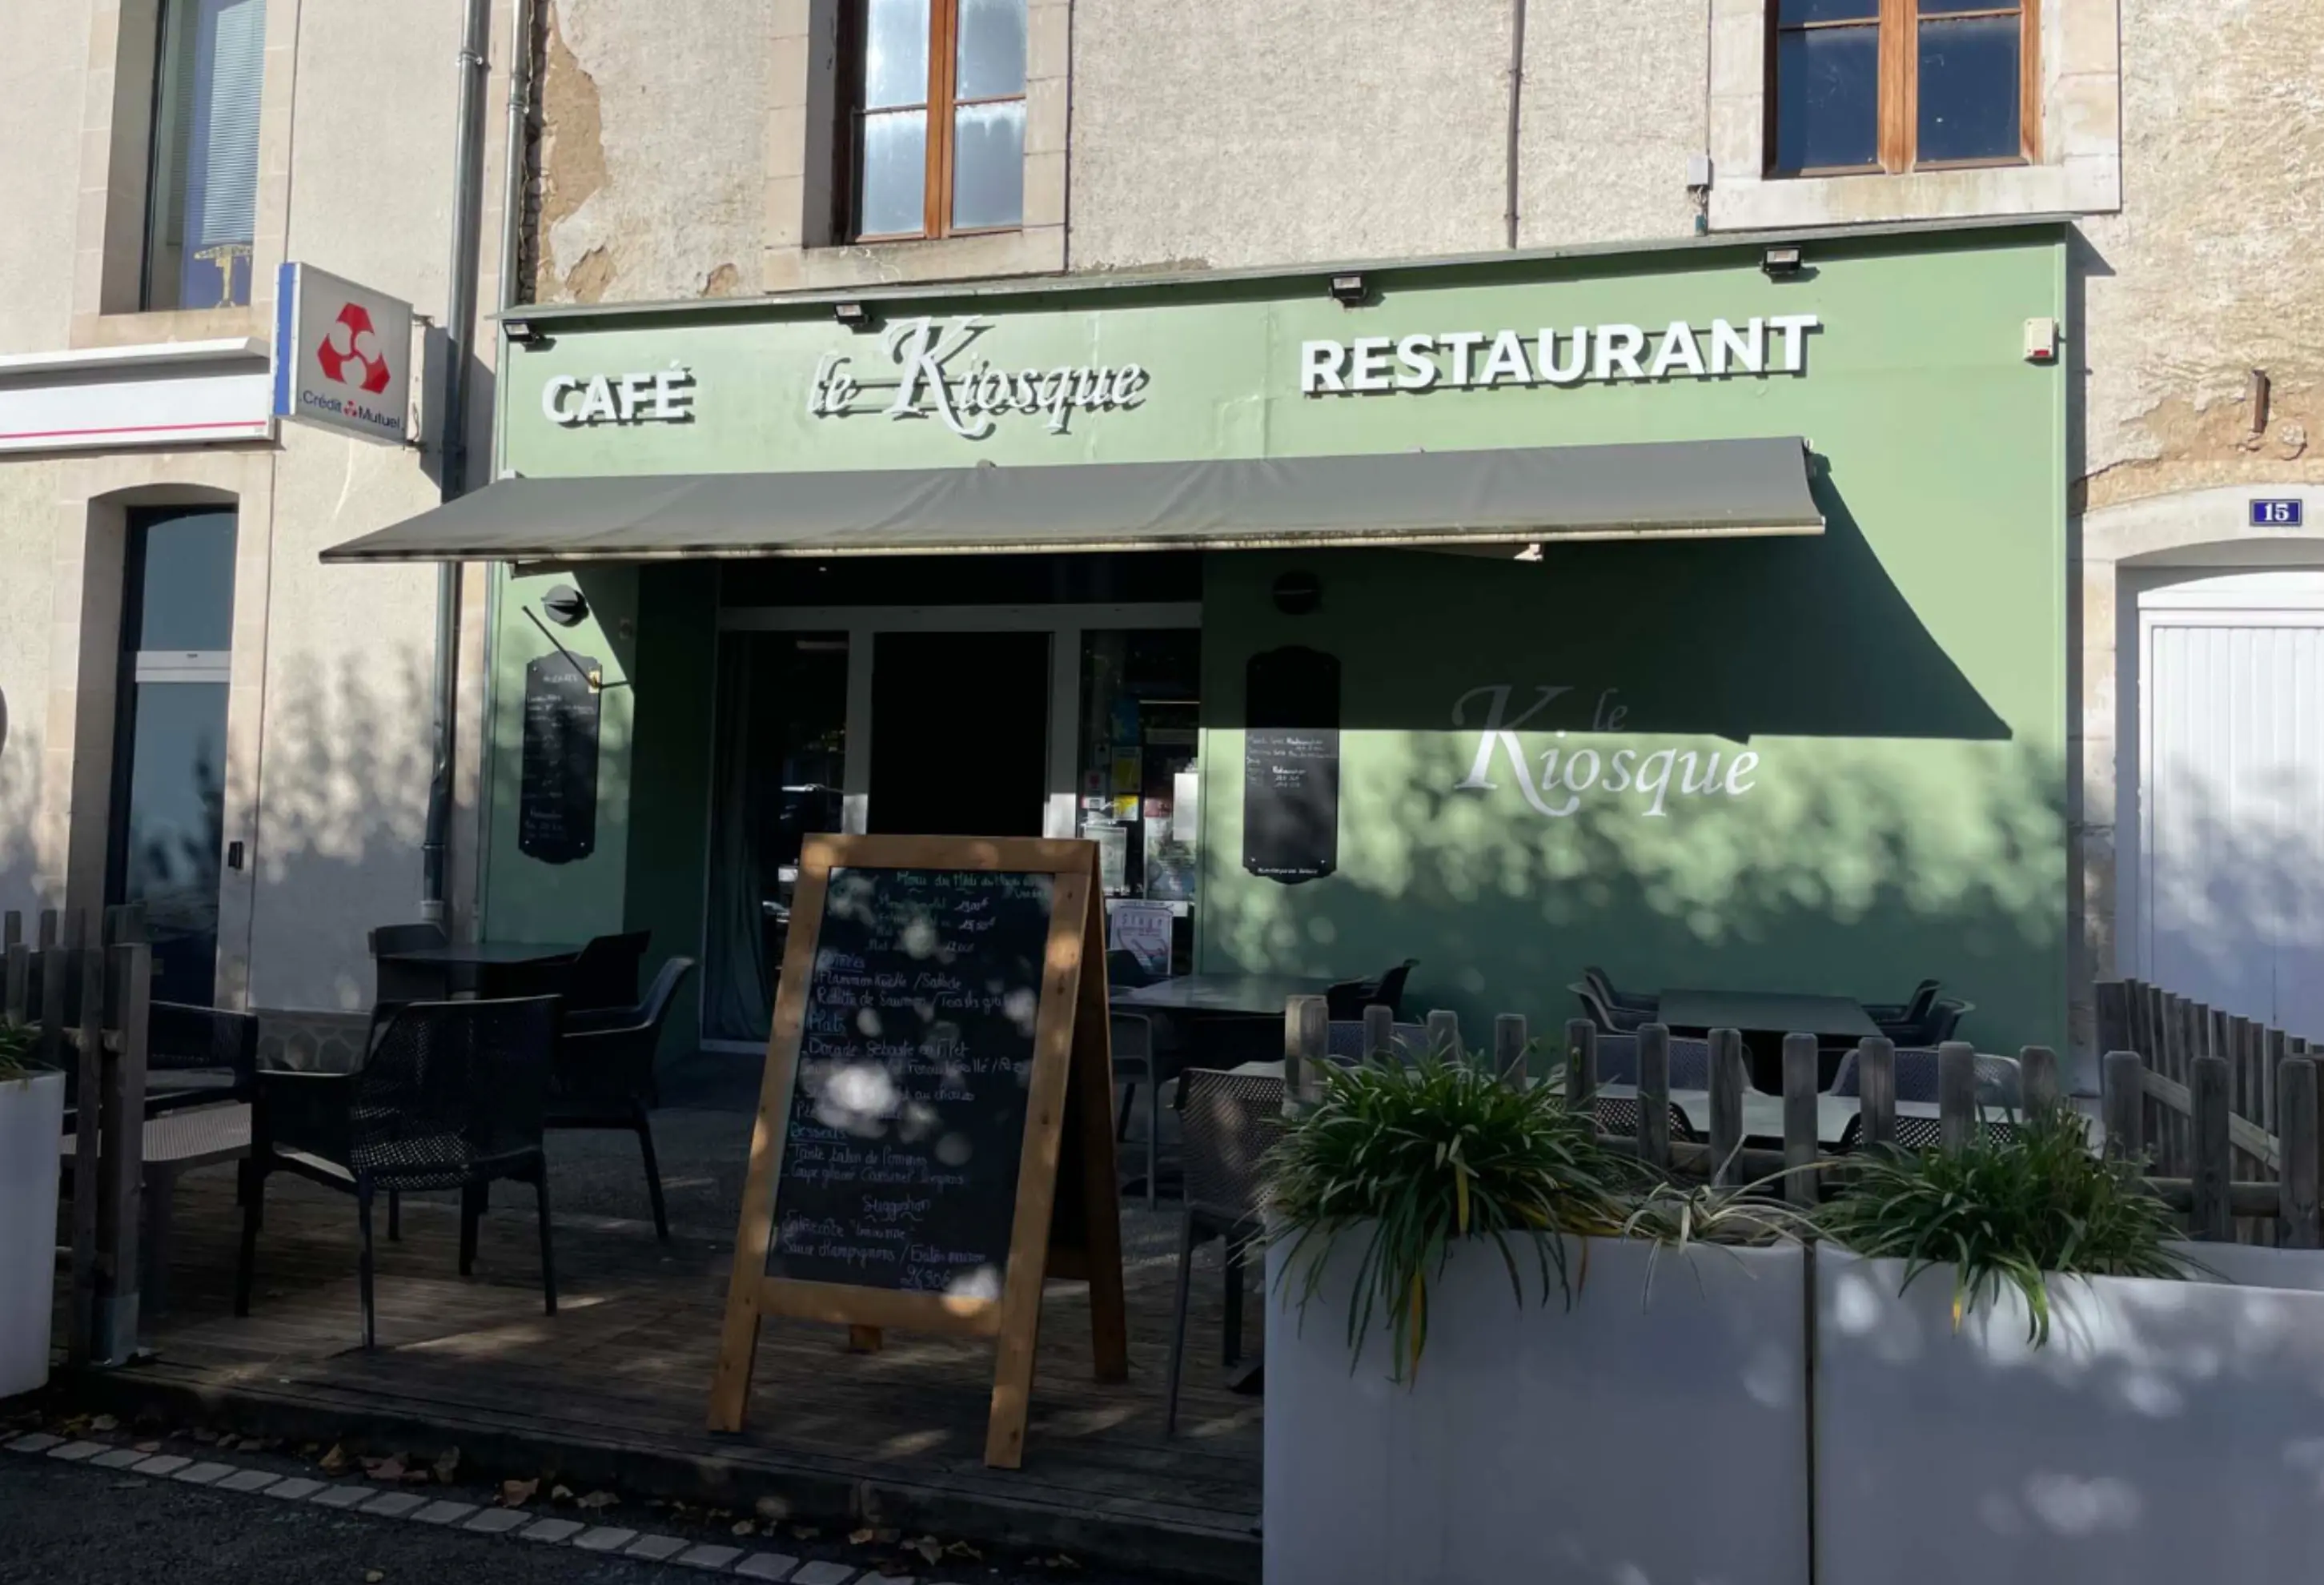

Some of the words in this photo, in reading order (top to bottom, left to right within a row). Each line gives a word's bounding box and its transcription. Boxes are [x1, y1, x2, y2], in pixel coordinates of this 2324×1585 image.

[807, 352, 854, 413] le
[881, 315, 1144, 438] Kiosque
[1300, 314, 1819, 392] RESTAURANT
[303, 389, 343, 415] Crédit
[359, 405, 401, 429] Mutuel
[541, 359, 687, 423] CAFÉ
[2263, 502, 2290, 521] 15
[1591, 687, 1628, 732] le
[1451, 684, 1760, 817] Kiosque
